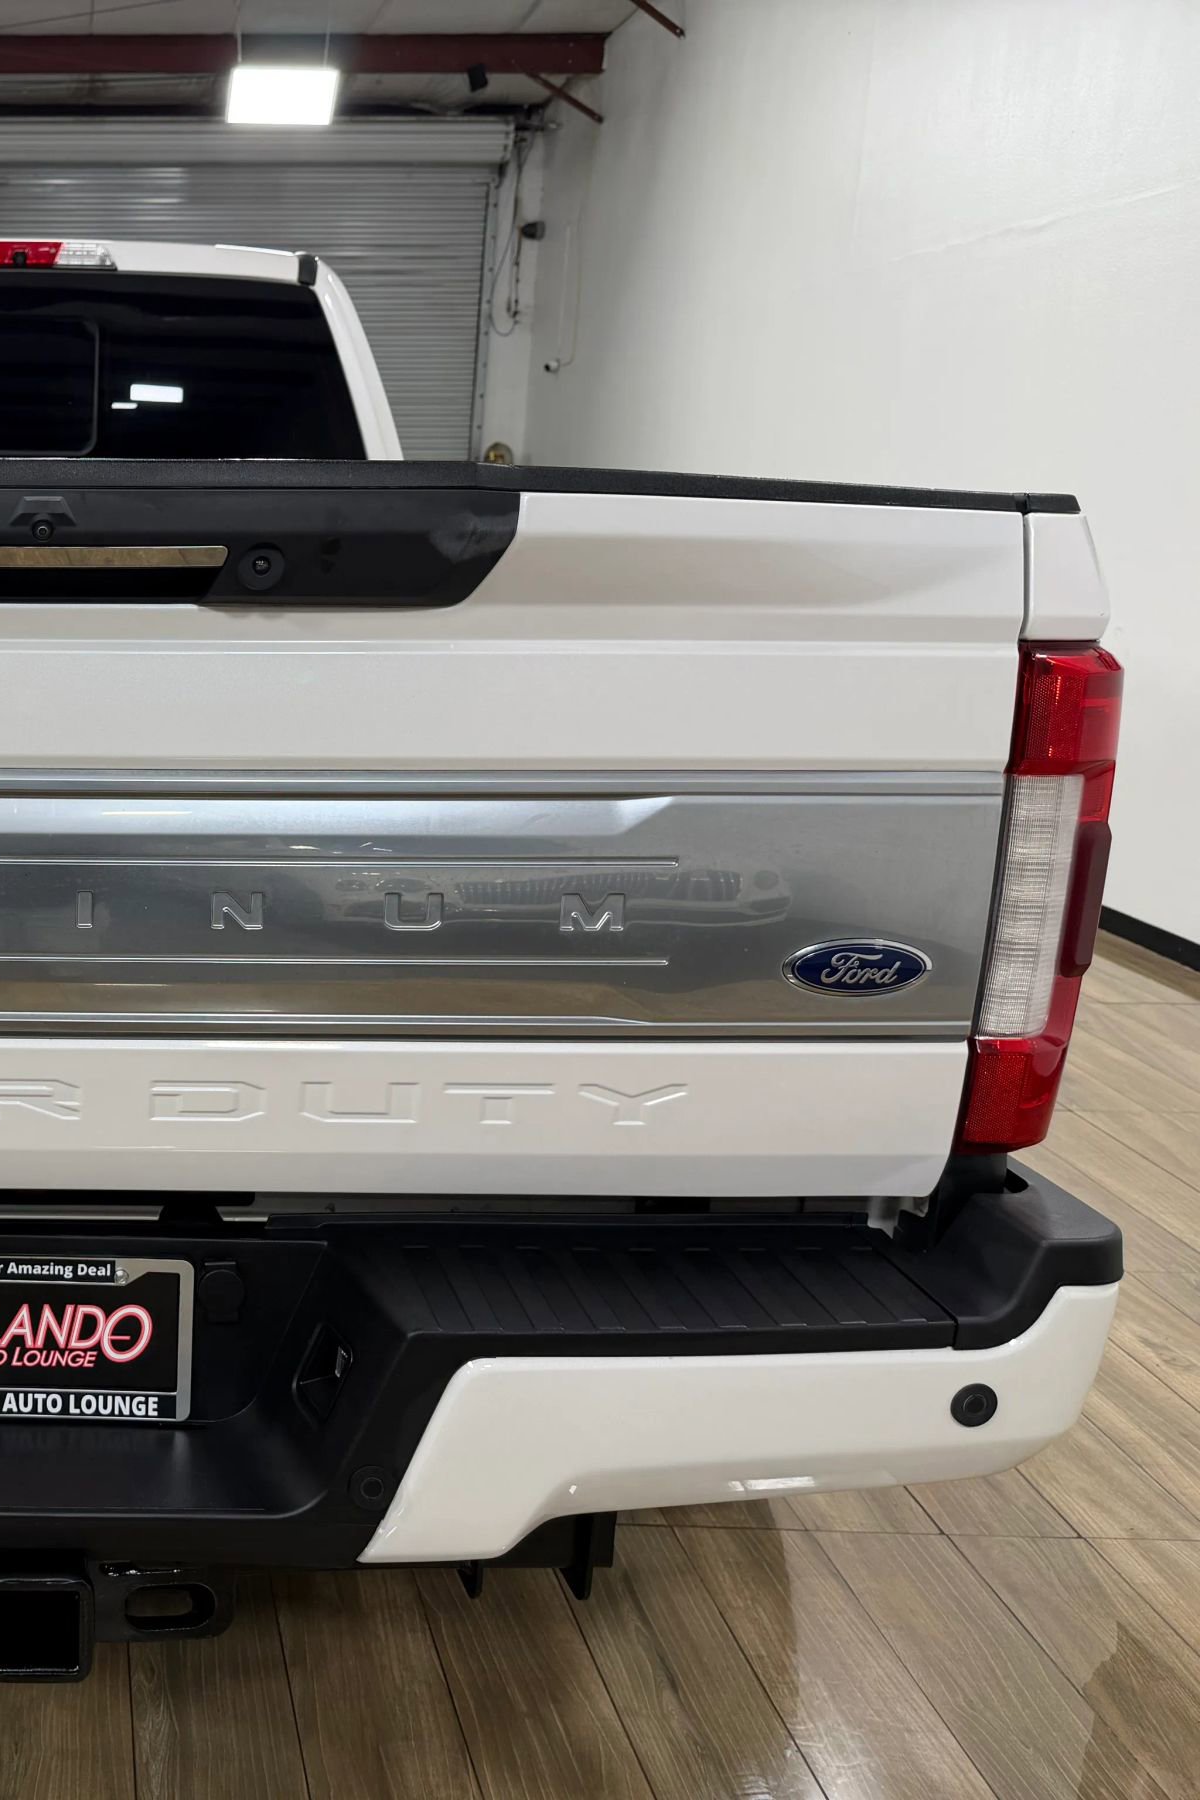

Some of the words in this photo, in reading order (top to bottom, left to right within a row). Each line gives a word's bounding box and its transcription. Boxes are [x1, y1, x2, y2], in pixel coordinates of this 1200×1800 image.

[820, 952, 902, 984] Ford
[148, 1080, 689, 1126] DUTY
[7, 1262, 73, 1279] Amazing
[77, 1263, 112, 1277] Deal
[11, 1348, 98, 1368] LOUNGE
[2, 1392, 63, 1415] AUTO
[68, 1393, 159, 1417] LOUNGE
